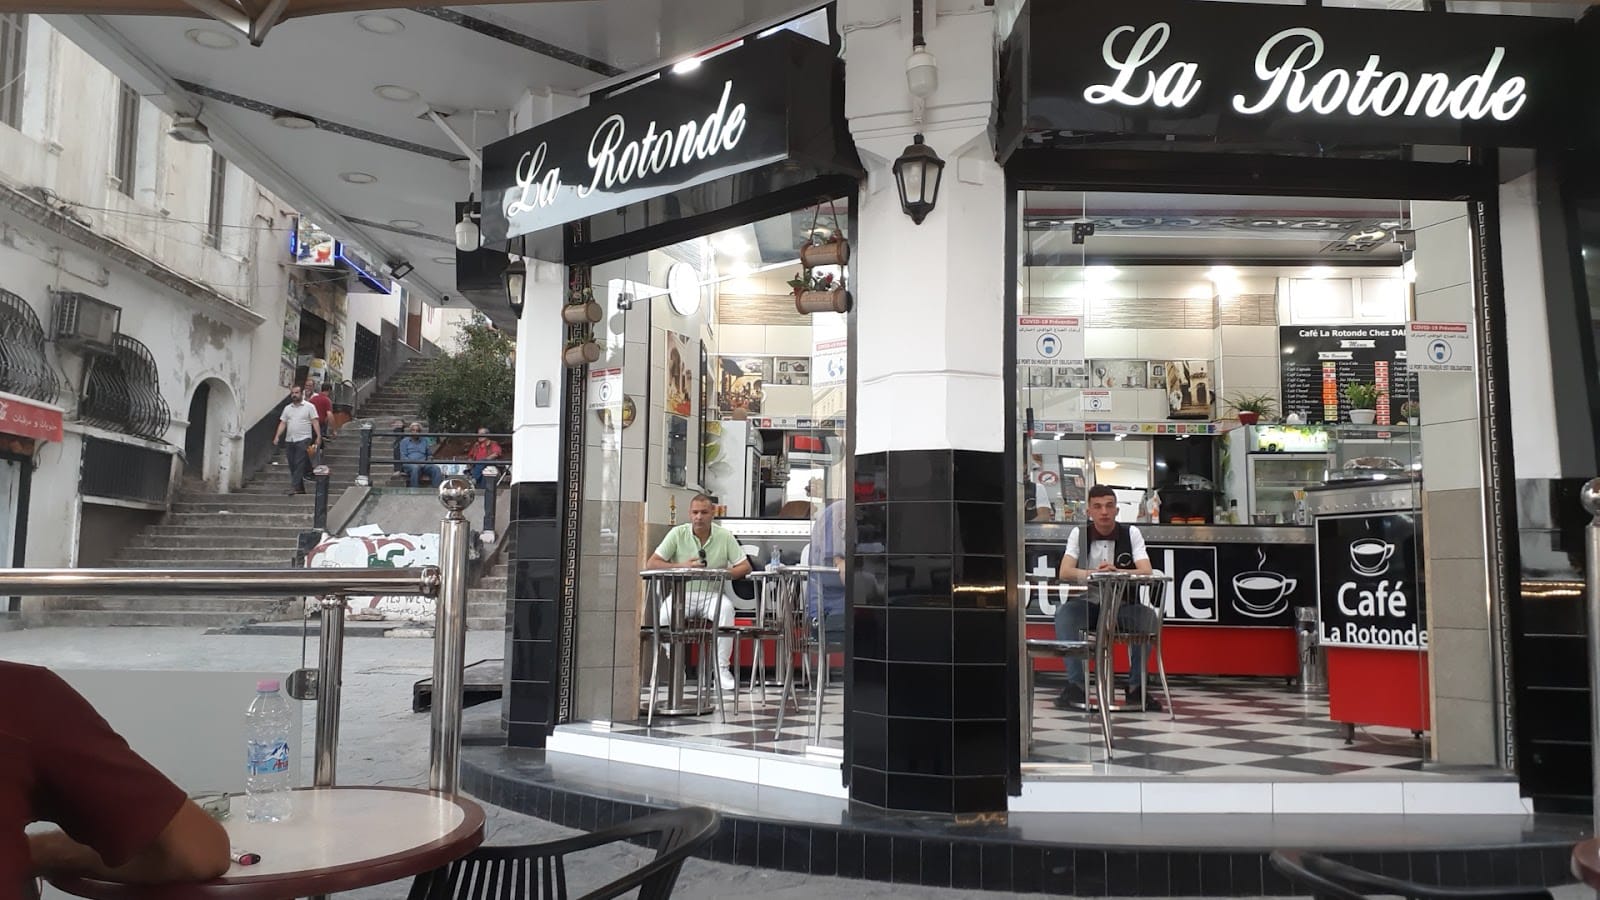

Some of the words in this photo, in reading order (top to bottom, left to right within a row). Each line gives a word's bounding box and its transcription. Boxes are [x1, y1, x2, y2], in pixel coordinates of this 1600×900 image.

[1083, 22, 1201, 108] La
[1232, 27, 1527, 121] Rotonde
[507, 141, 562, 217] La
[577, 80, 746, 199] Rotonde
[1299, 329, 1318, 337] Café
[1331, 329, 1367, 337] Rotonde
[1369, 329, 1390, 337] Chez
[1337, 580, 1407, 617] Café
[1320, 621, 1341, 642] La
[1345, 622, 1429, 646] Rotonde
